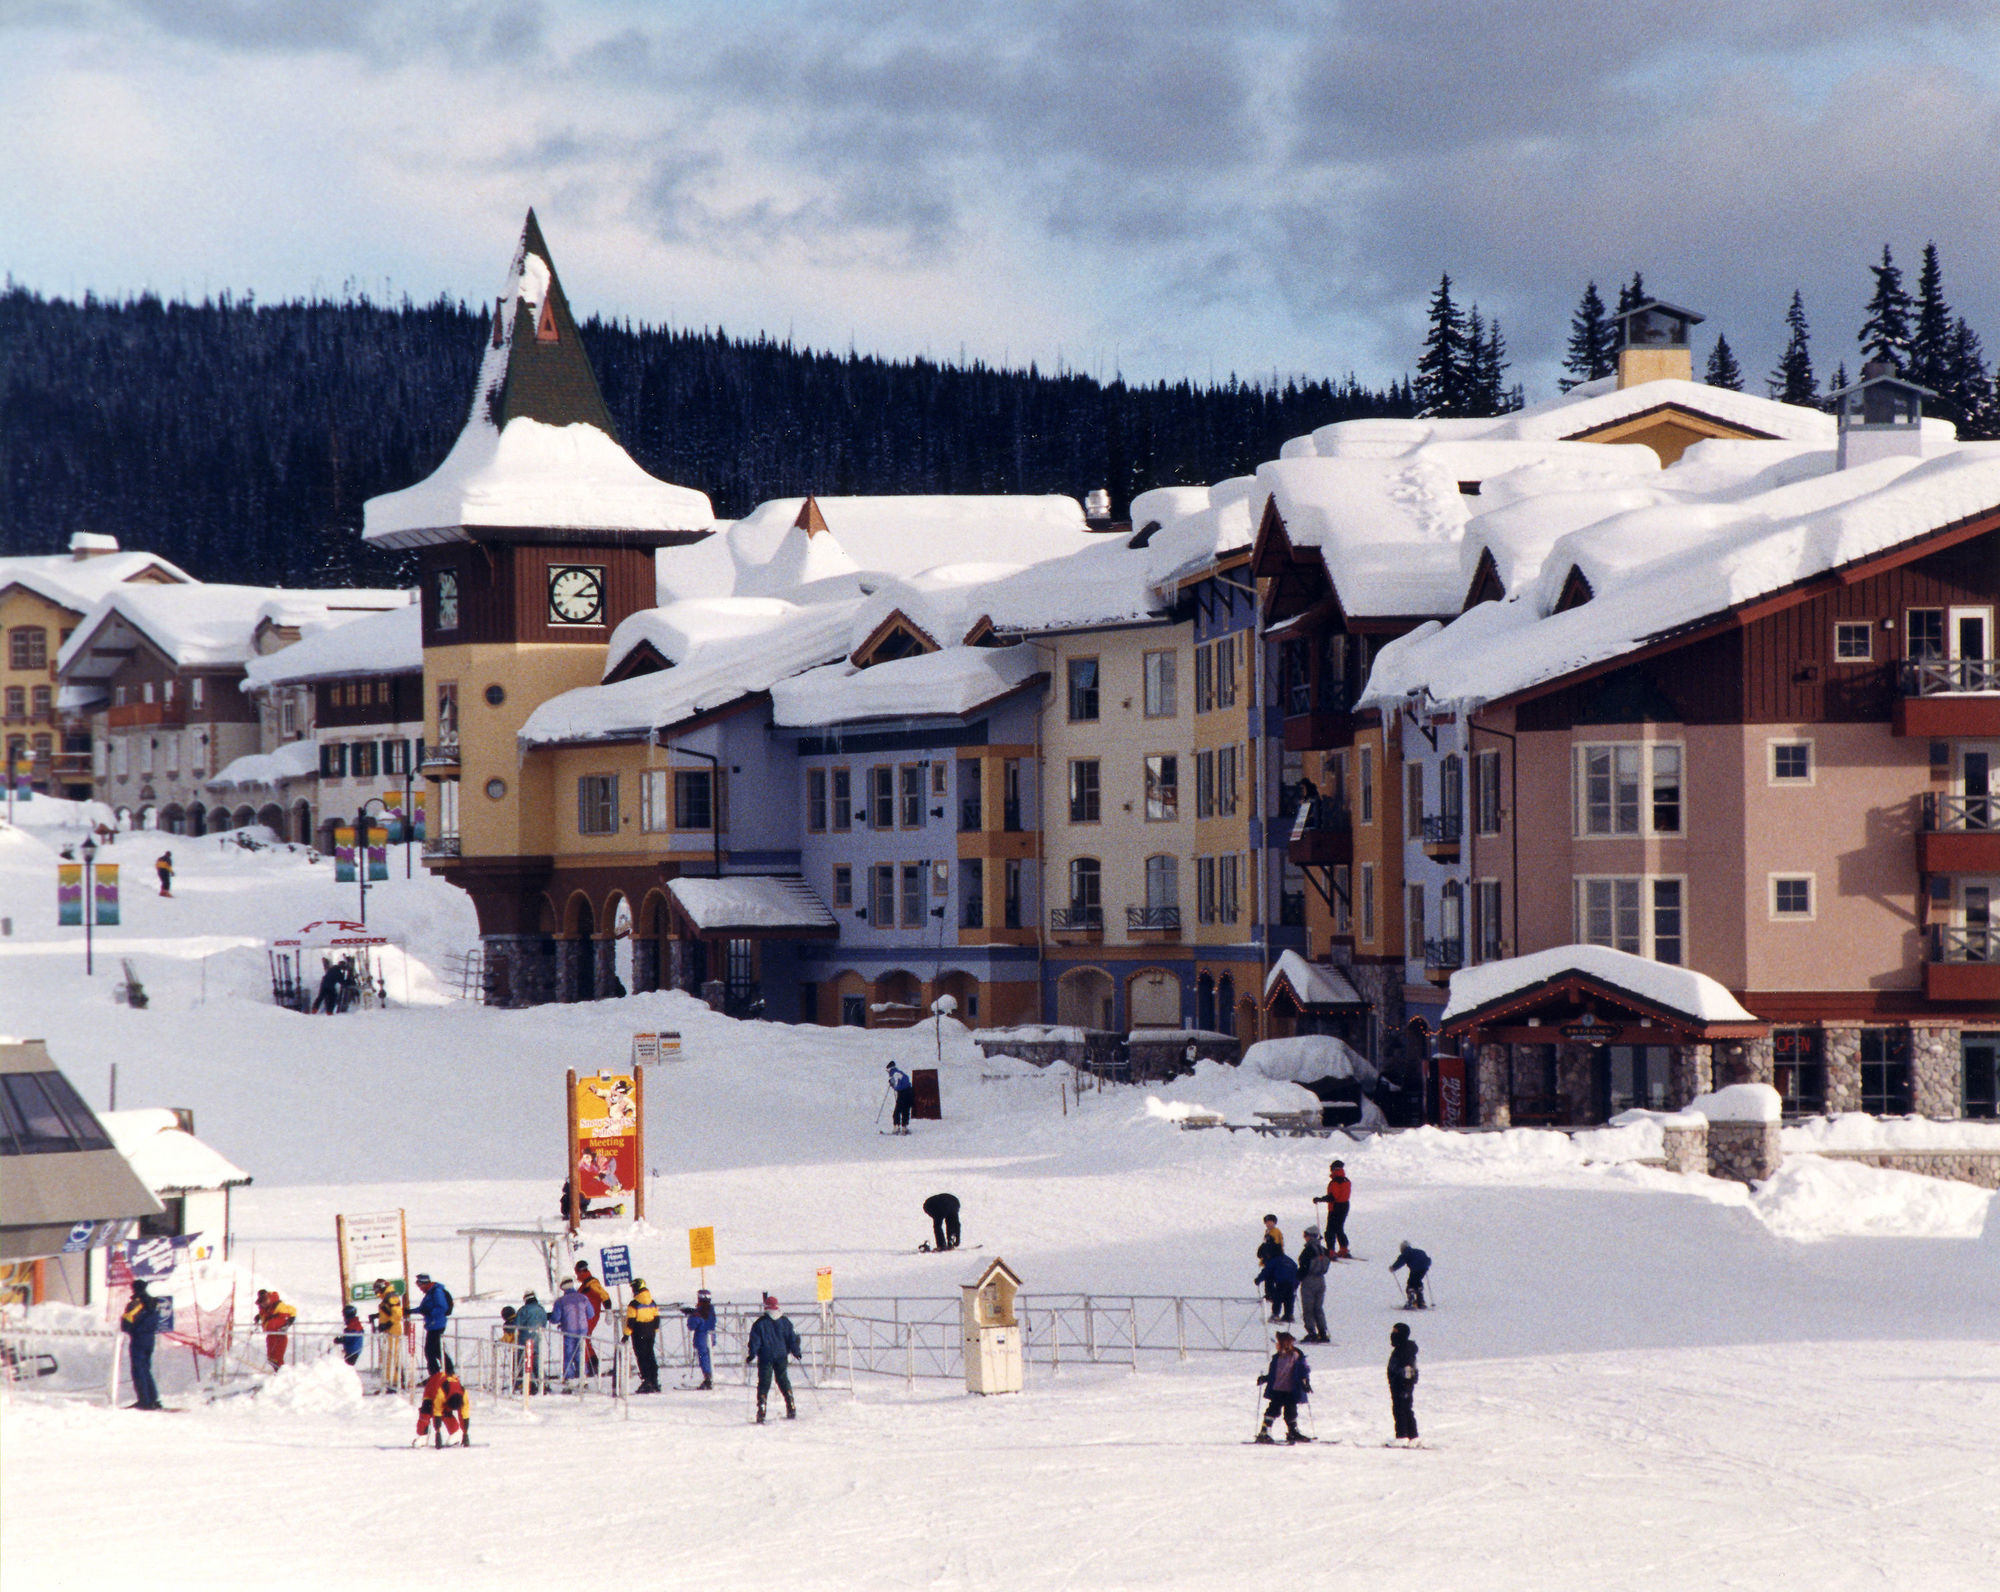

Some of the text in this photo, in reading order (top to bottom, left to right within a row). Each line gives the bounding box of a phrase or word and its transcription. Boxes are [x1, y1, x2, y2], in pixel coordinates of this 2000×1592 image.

[330, 937, 387, 945] ROSSIGNOL
[589, 1138, 624, 1147] Meeting
[596, 1148, 618, 1156] Place
